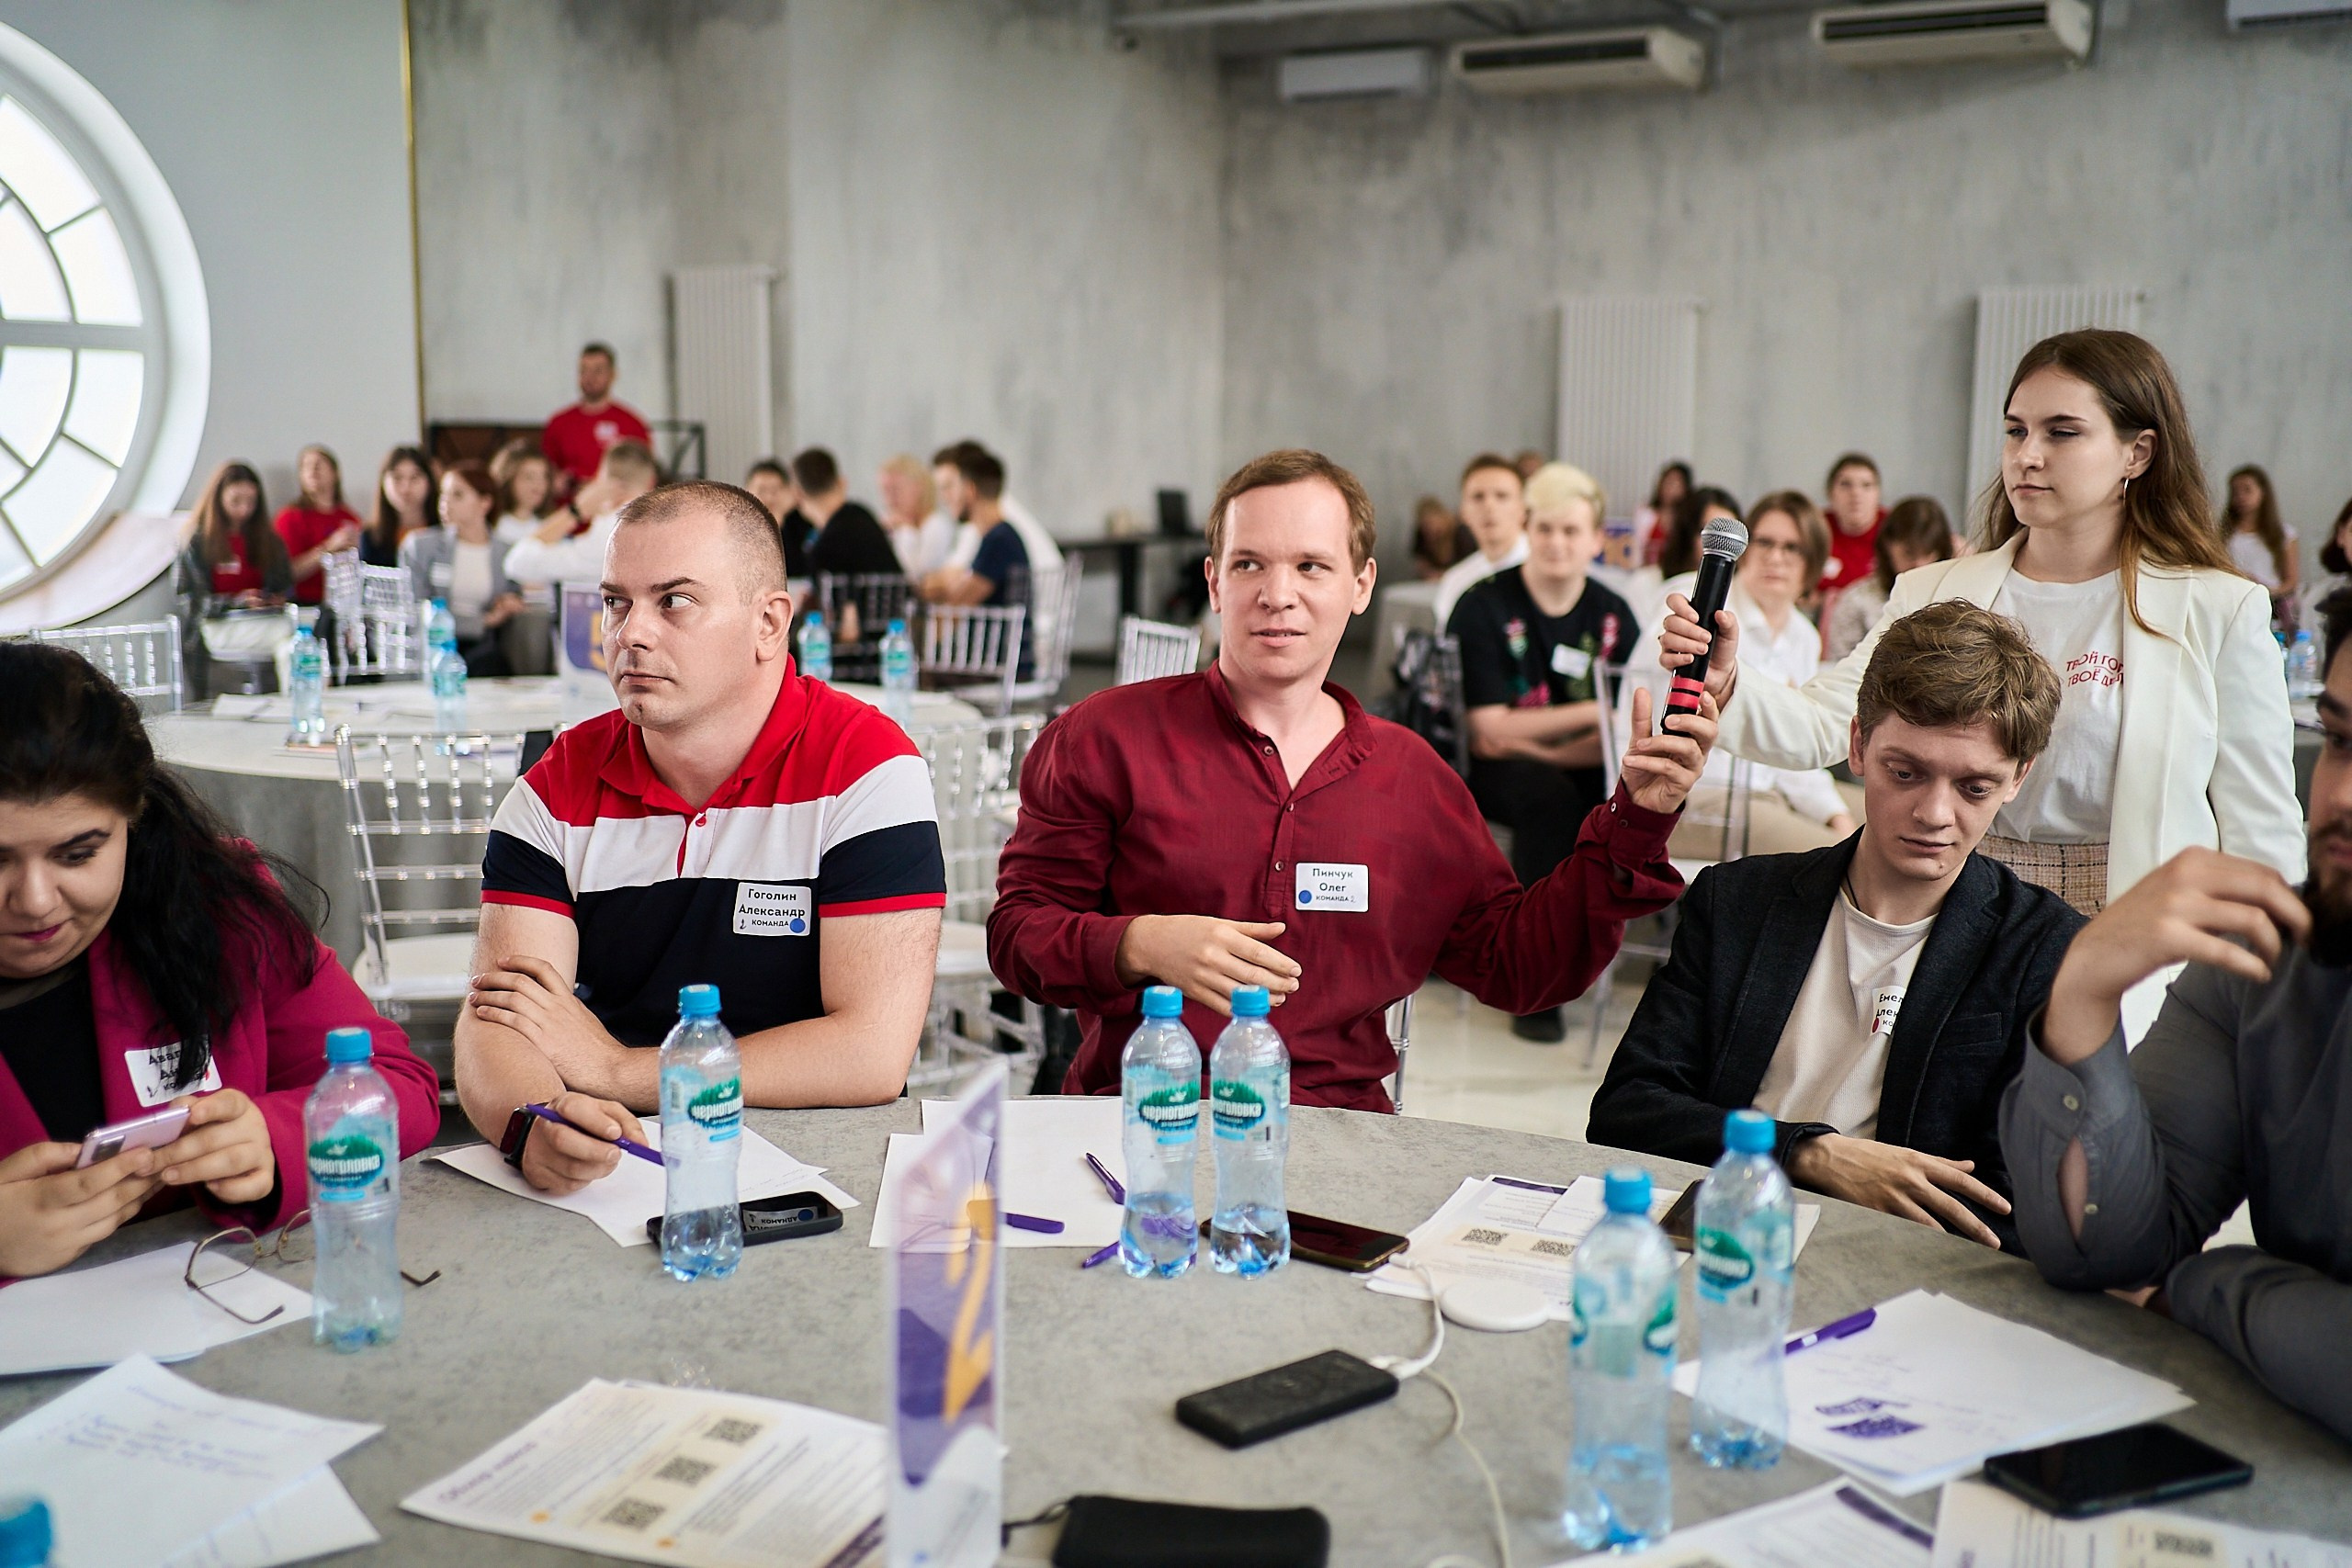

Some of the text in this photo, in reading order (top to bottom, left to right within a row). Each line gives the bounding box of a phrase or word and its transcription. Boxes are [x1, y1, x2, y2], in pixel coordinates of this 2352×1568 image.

[1312, 868, 1353, 880] Пинчук
[1319, 882, 1347, 892] Олег
[748, 888, 797, 901] Гоголин
[1316, 895, 1350, 903] КОМАНДА
[738, 903, 806, 919] Александр
